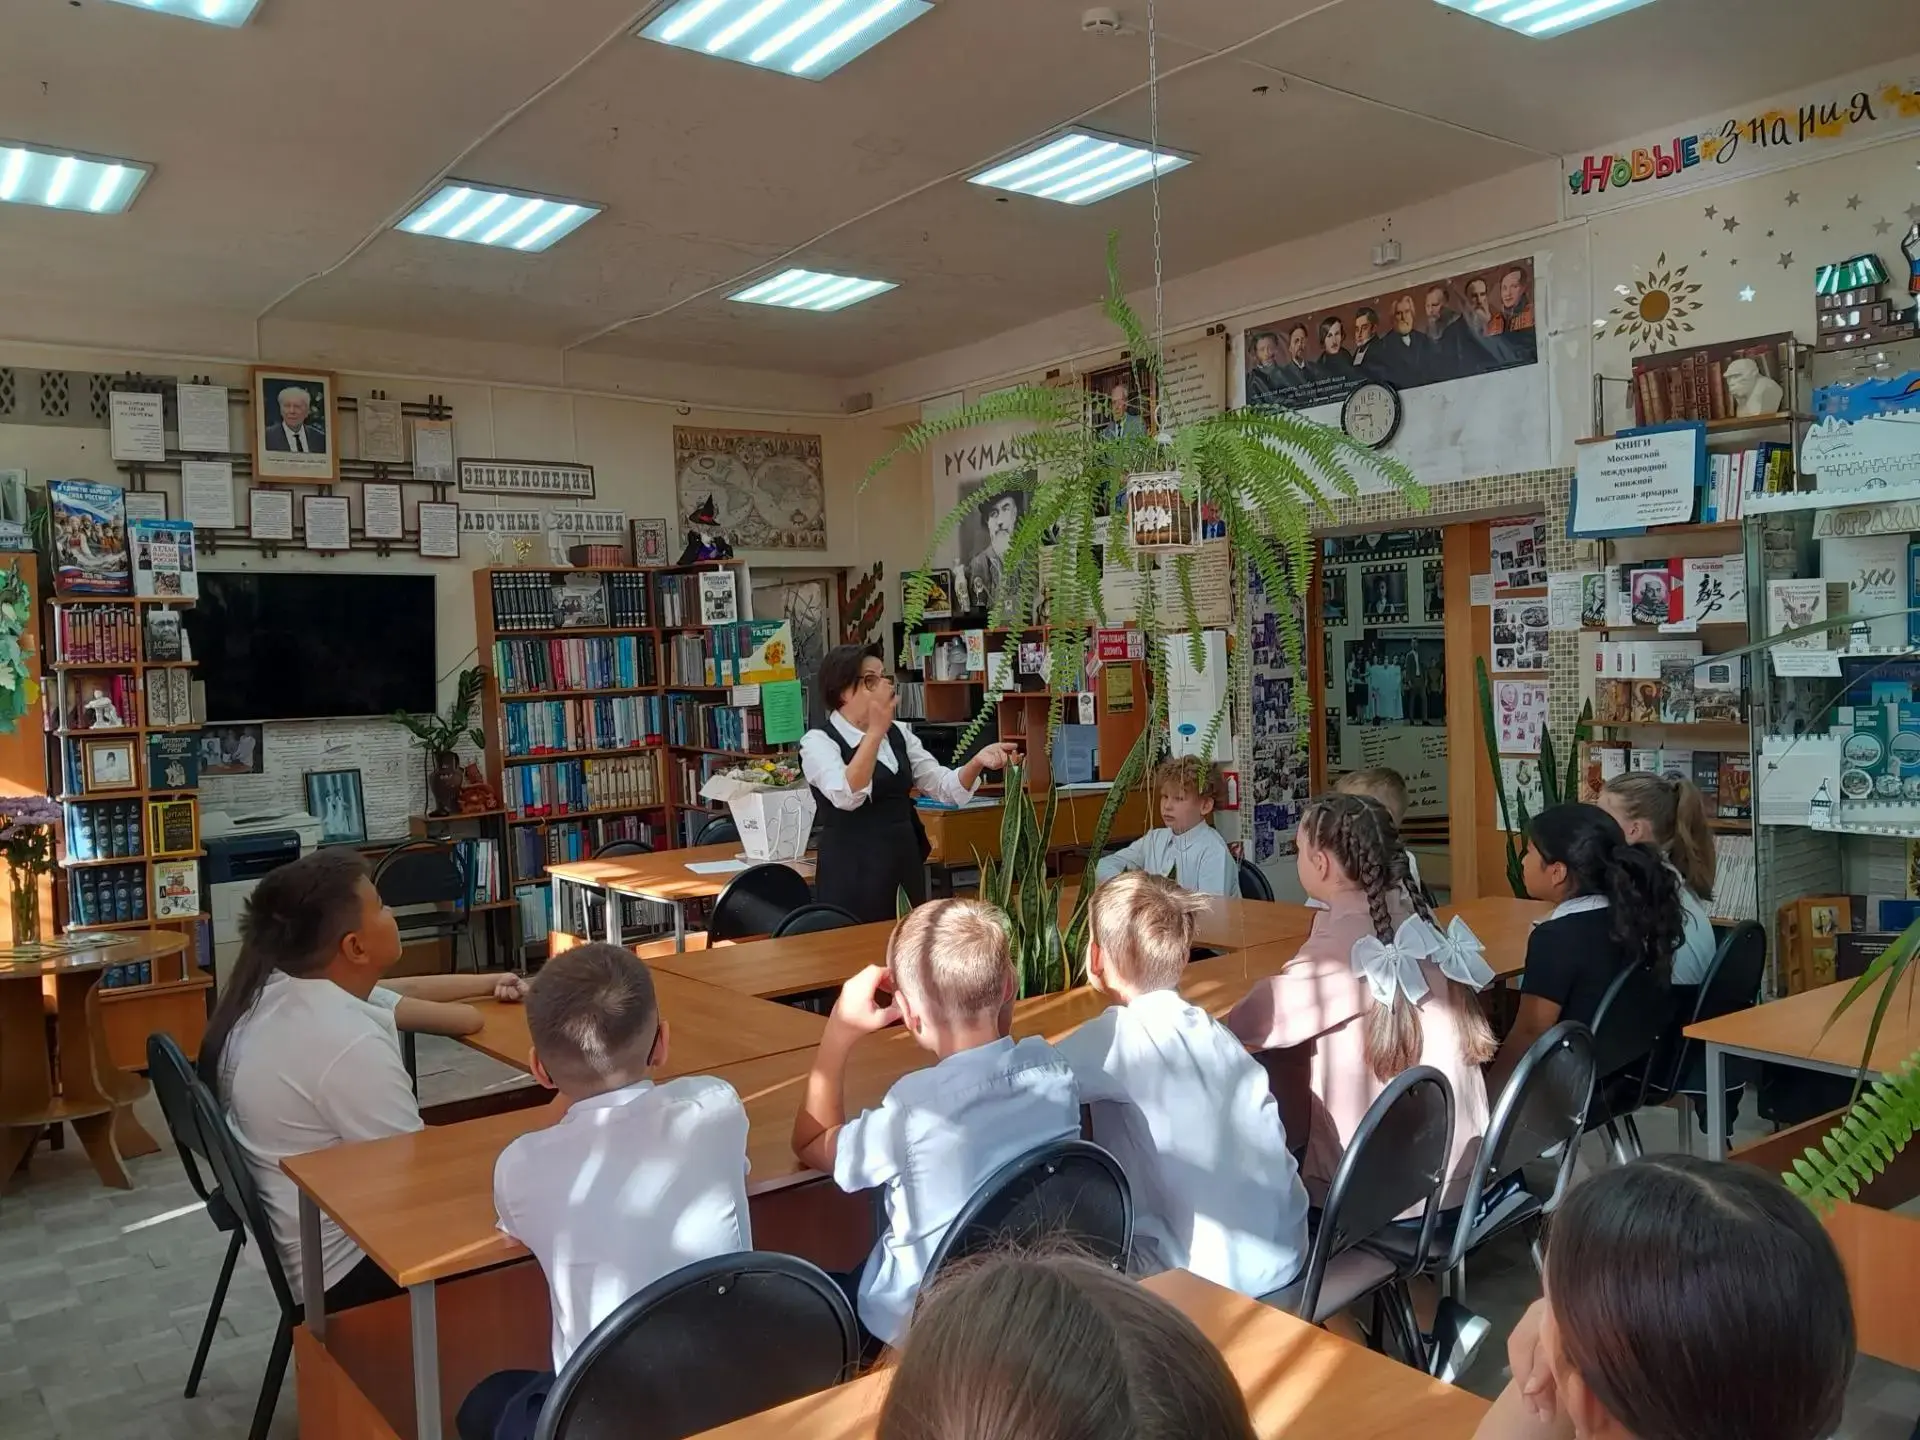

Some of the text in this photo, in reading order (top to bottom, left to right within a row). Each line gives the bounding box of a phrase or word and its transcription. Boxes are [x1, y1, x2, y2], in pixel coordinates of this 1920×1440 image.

[1581, 92, 1877, 194] НОВЫЕ знания
[1615, 439, 1651, 450] КНИГИ
[944, 436, 1037, 476] PYGMALI
[1607, 449, 1660, 463] Московской
[1600, 461, 1667, 476] международной
[463, 467, 591, 491] ЭНЦИКЛОПЕДИИ
[1614, 476, 1653, 488] книжной
[1640, 488, 1679, 500] ярмарки
[459, 513, 539, 531] АВОЧНЫЕ
[1851, 567, 1896, 593] 300
[1130, 649, 1140, 657] 112
